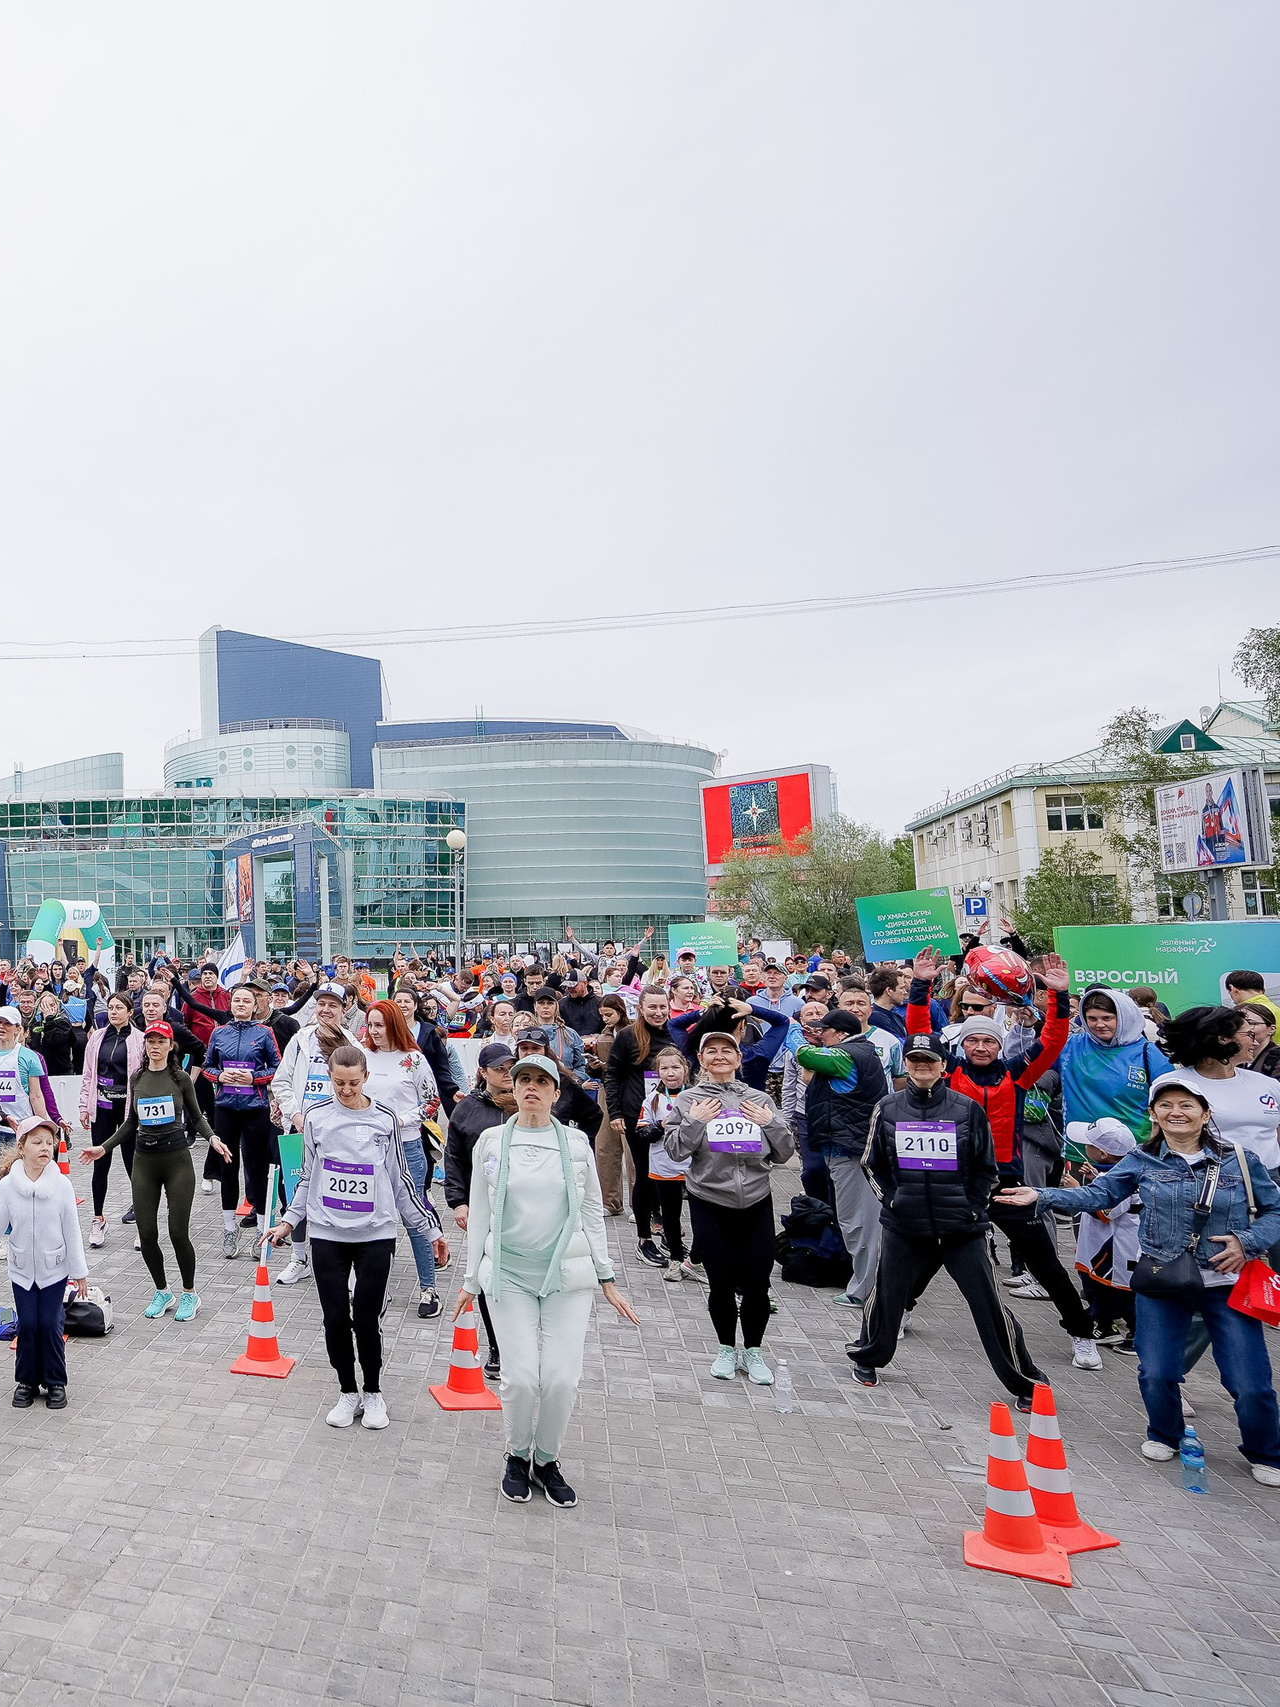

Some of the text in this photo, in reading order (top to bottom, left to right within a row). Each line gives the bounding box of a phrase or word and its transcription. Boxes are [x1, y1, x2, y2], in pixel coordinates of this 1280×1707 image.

[970, 899, 982, 914] P
[72, 909, 92, 920] СТАРТ
[887, 909, 932, 919] ХМАО-ЮГРЫ
[885, 919, 926, 929] «ДИРЕКЦИЯ
[886, 925, 942, 936] ЭКСПЛУАТАЦИИ
[871, 932, 949, 946] СЛУЖЕБНЫХ ЗДАНИЙ»
[1160, 938, 1197, 946] зелёный
[1155, 946, 1195, 954] марафон
[1075, 968, 1178, 984] ВЗРОСЛЫЙ
[305, 1082, 323, 1092] 659
[144, 1105, 166, 1117] 731
[715, 1123, 753, 1135] 2097
[905, 1138, 949, 1152] 2110
[329, 1178, 368, 1195] 2023
